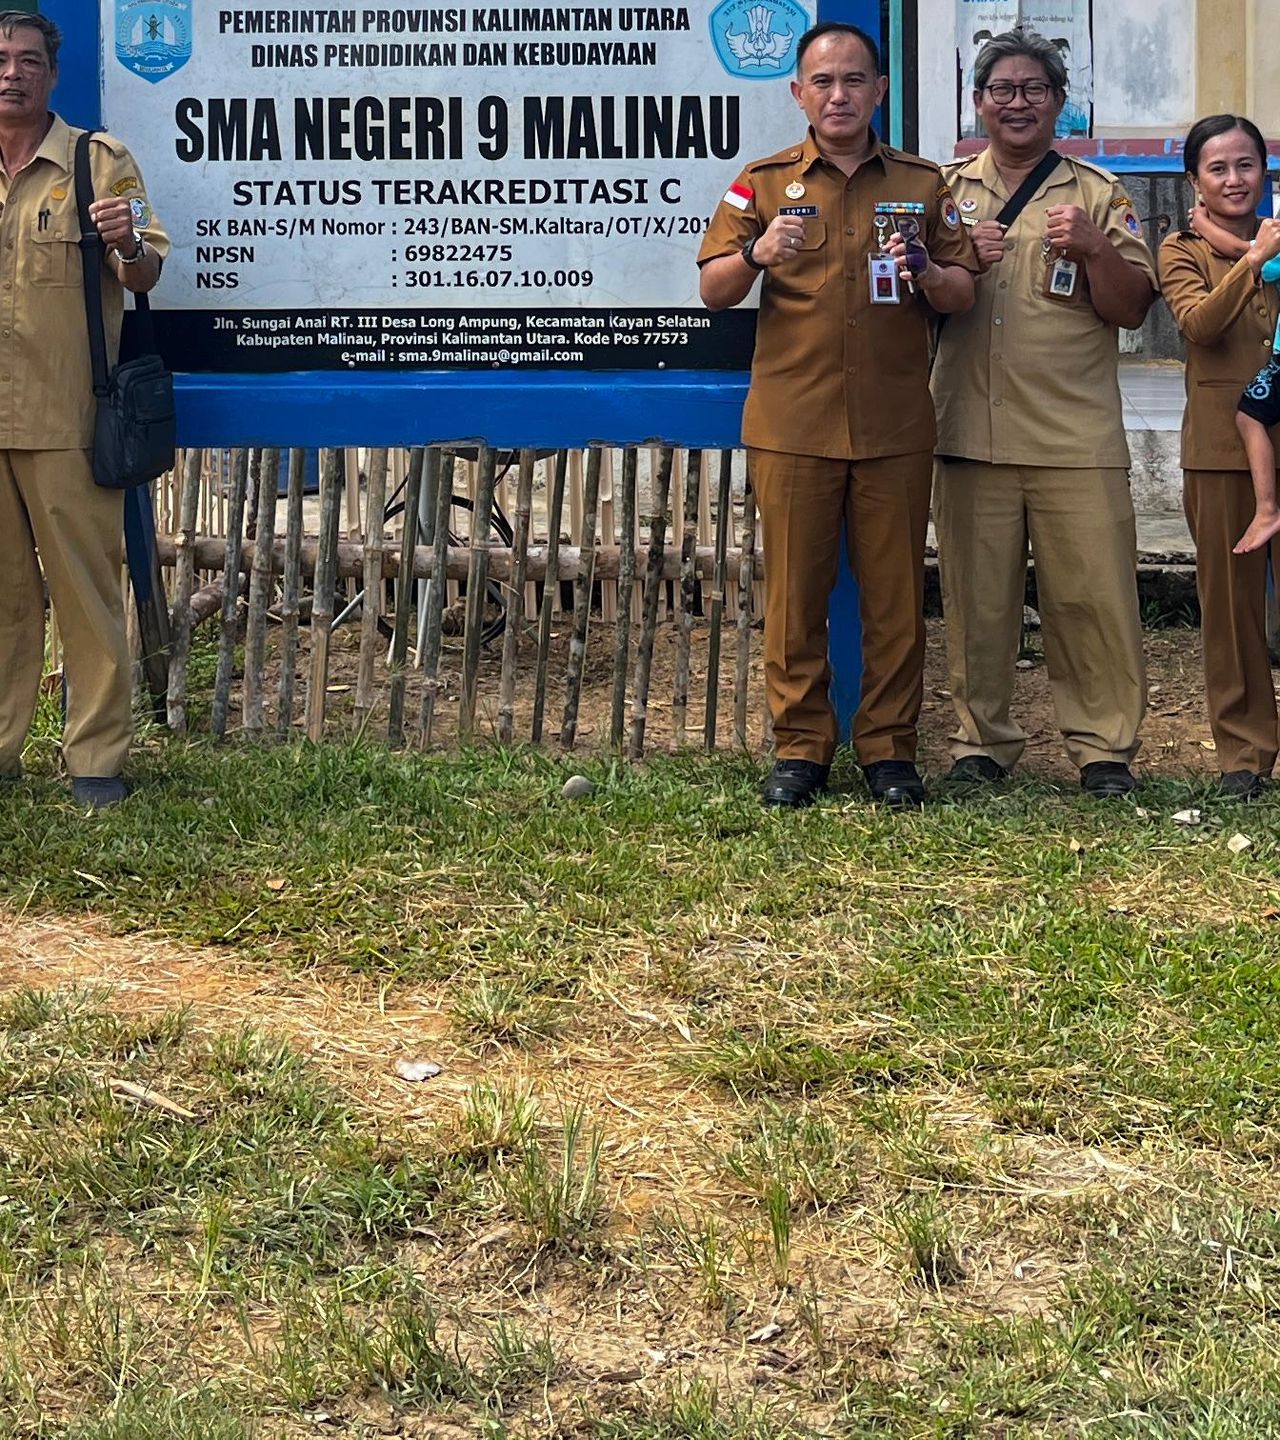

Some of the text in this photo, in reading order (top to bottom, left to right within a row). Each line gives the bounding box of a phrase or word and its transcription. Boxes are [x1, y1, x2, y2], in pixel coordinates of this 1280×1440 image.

[219, 7, 690, 34] PEMERINTAH PROVINSI KALIMANTAN UTARA
[251, 42, 656, 68] DINAS PENDIDIKAN DAN KEBUDAYAAN
[175, 95, 740, 163] SMA NEGERI 9 MALINAU
[233, 178, 681, 207] STATUS TERAKREDITASI C
[196, 219, 221, 237] SK
[227, 218, 315, 240] BAN-S/M
[322, 218, 386, 236] Nomor
[404, 216, 710, 238] 243/BAN-SM.Kaltara/OT/X/201
[196, 246, 255, 264] NPSN
[405, 244, 512, 262] 69822475
[196, 271, 239, 289] NSS
[405, 270, 594, 288] 301.16.07.10.009
[214, 314, 711, 332] Jln. Sungai Anai RT. III Desa Long Ampung, Kecamatan Kayan Selatan
[236, 331, 689, 349] Kabupaten Malinau, Provinsi Kalimantan Utara. Kode Pos 77573
[341, 348, 386, 363] e-mail
[398, 348, 584, 365] sma.9malinau@gmail.com
